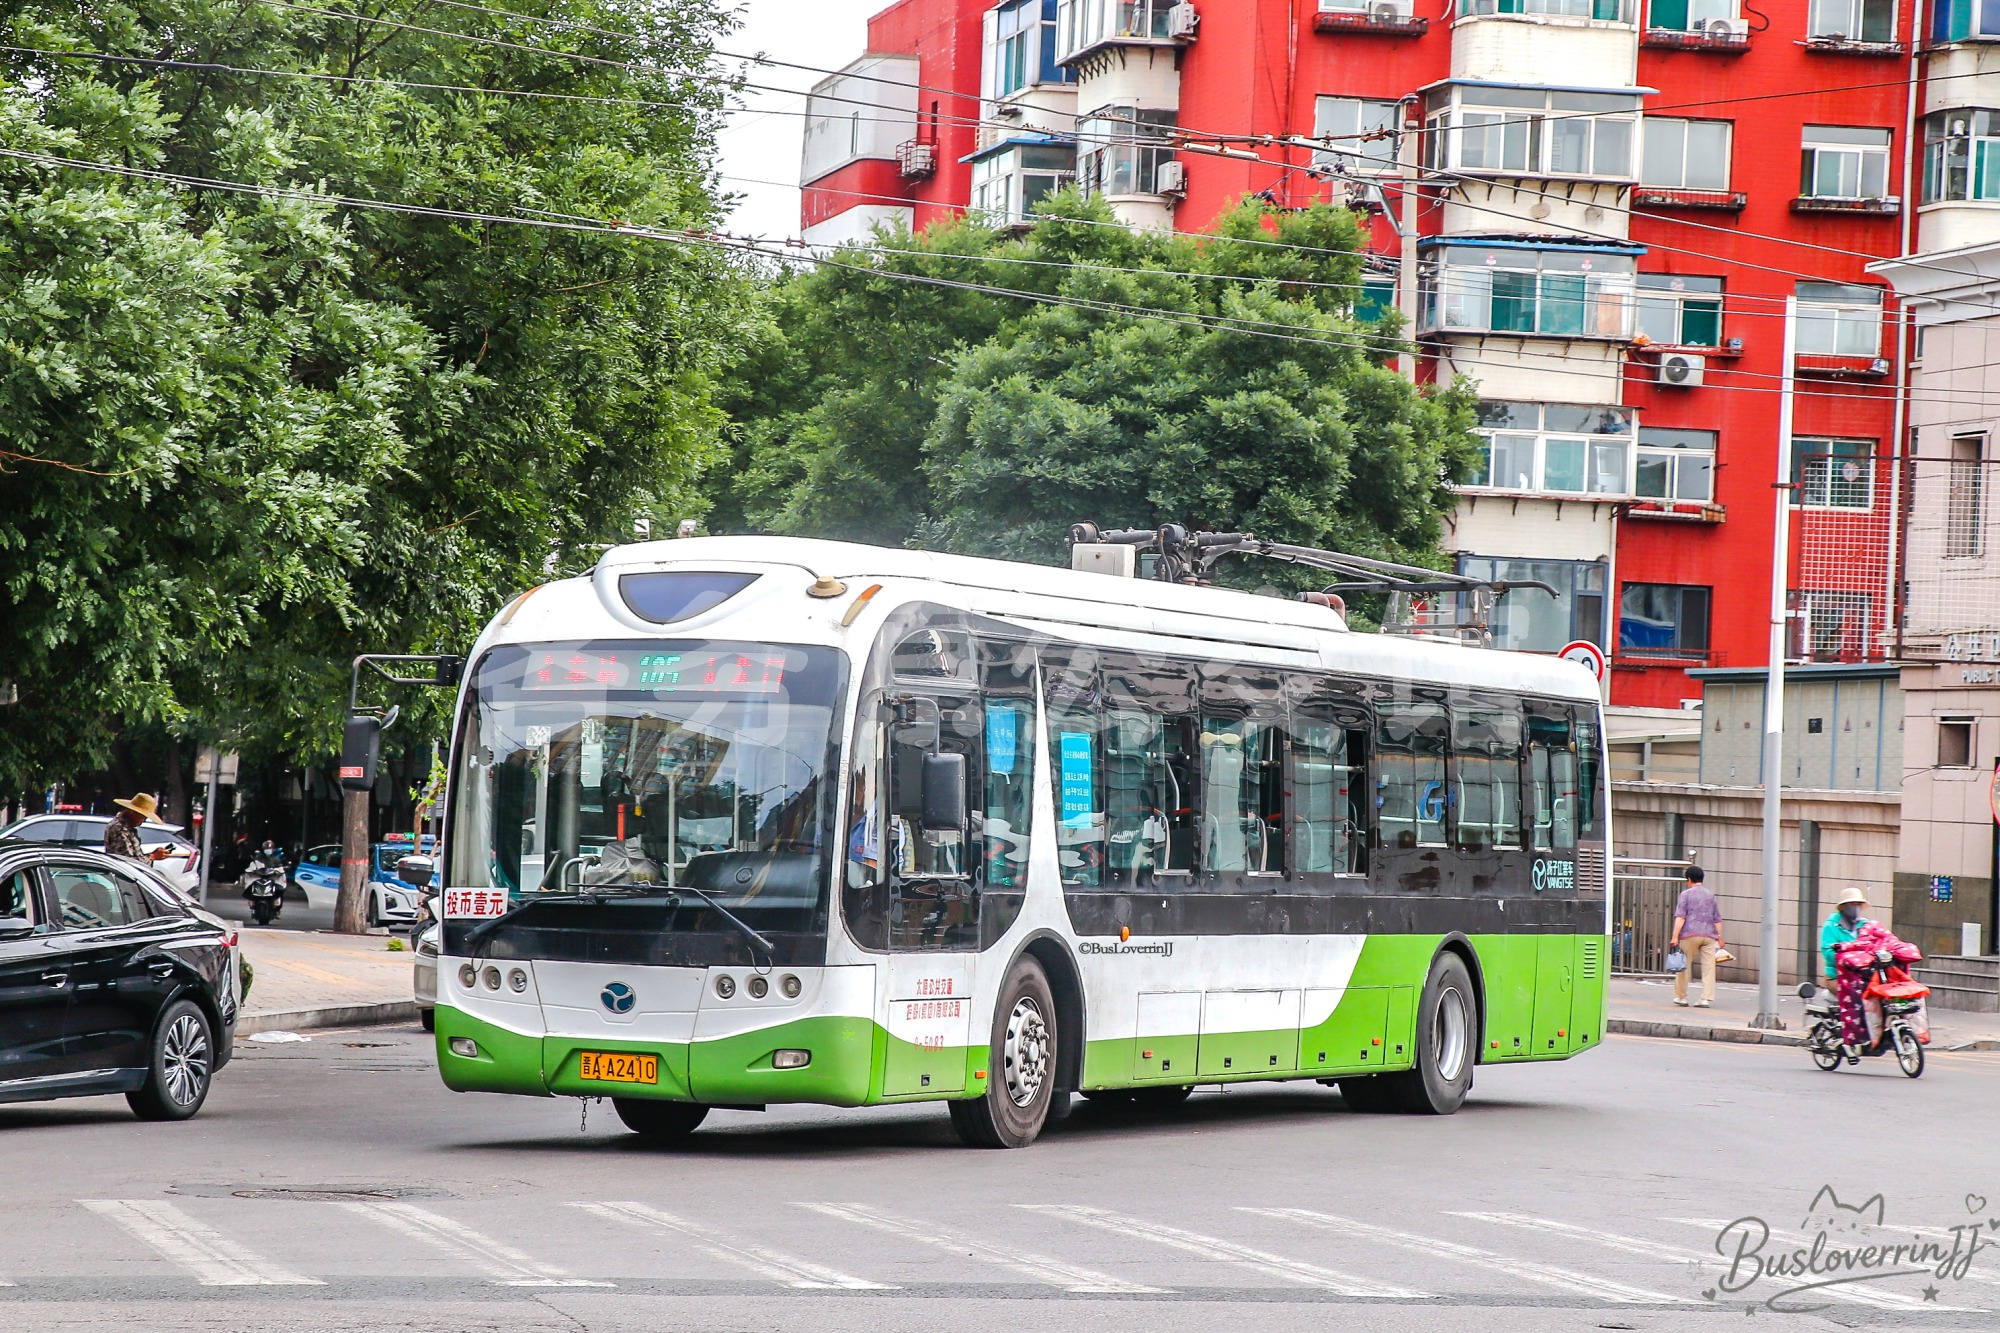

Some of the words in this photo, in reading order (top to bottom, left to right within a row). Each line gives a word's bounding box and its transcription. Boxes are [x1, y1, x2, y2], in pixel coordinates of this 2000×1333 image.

[1962, 670, 1993, 683] PUBLIC
[1547, 860, 1574, 876] 扬子江客车
[1547, 876, 1574, 889] YANGTSE
[446, 890, 503, 916] 投币壹元
